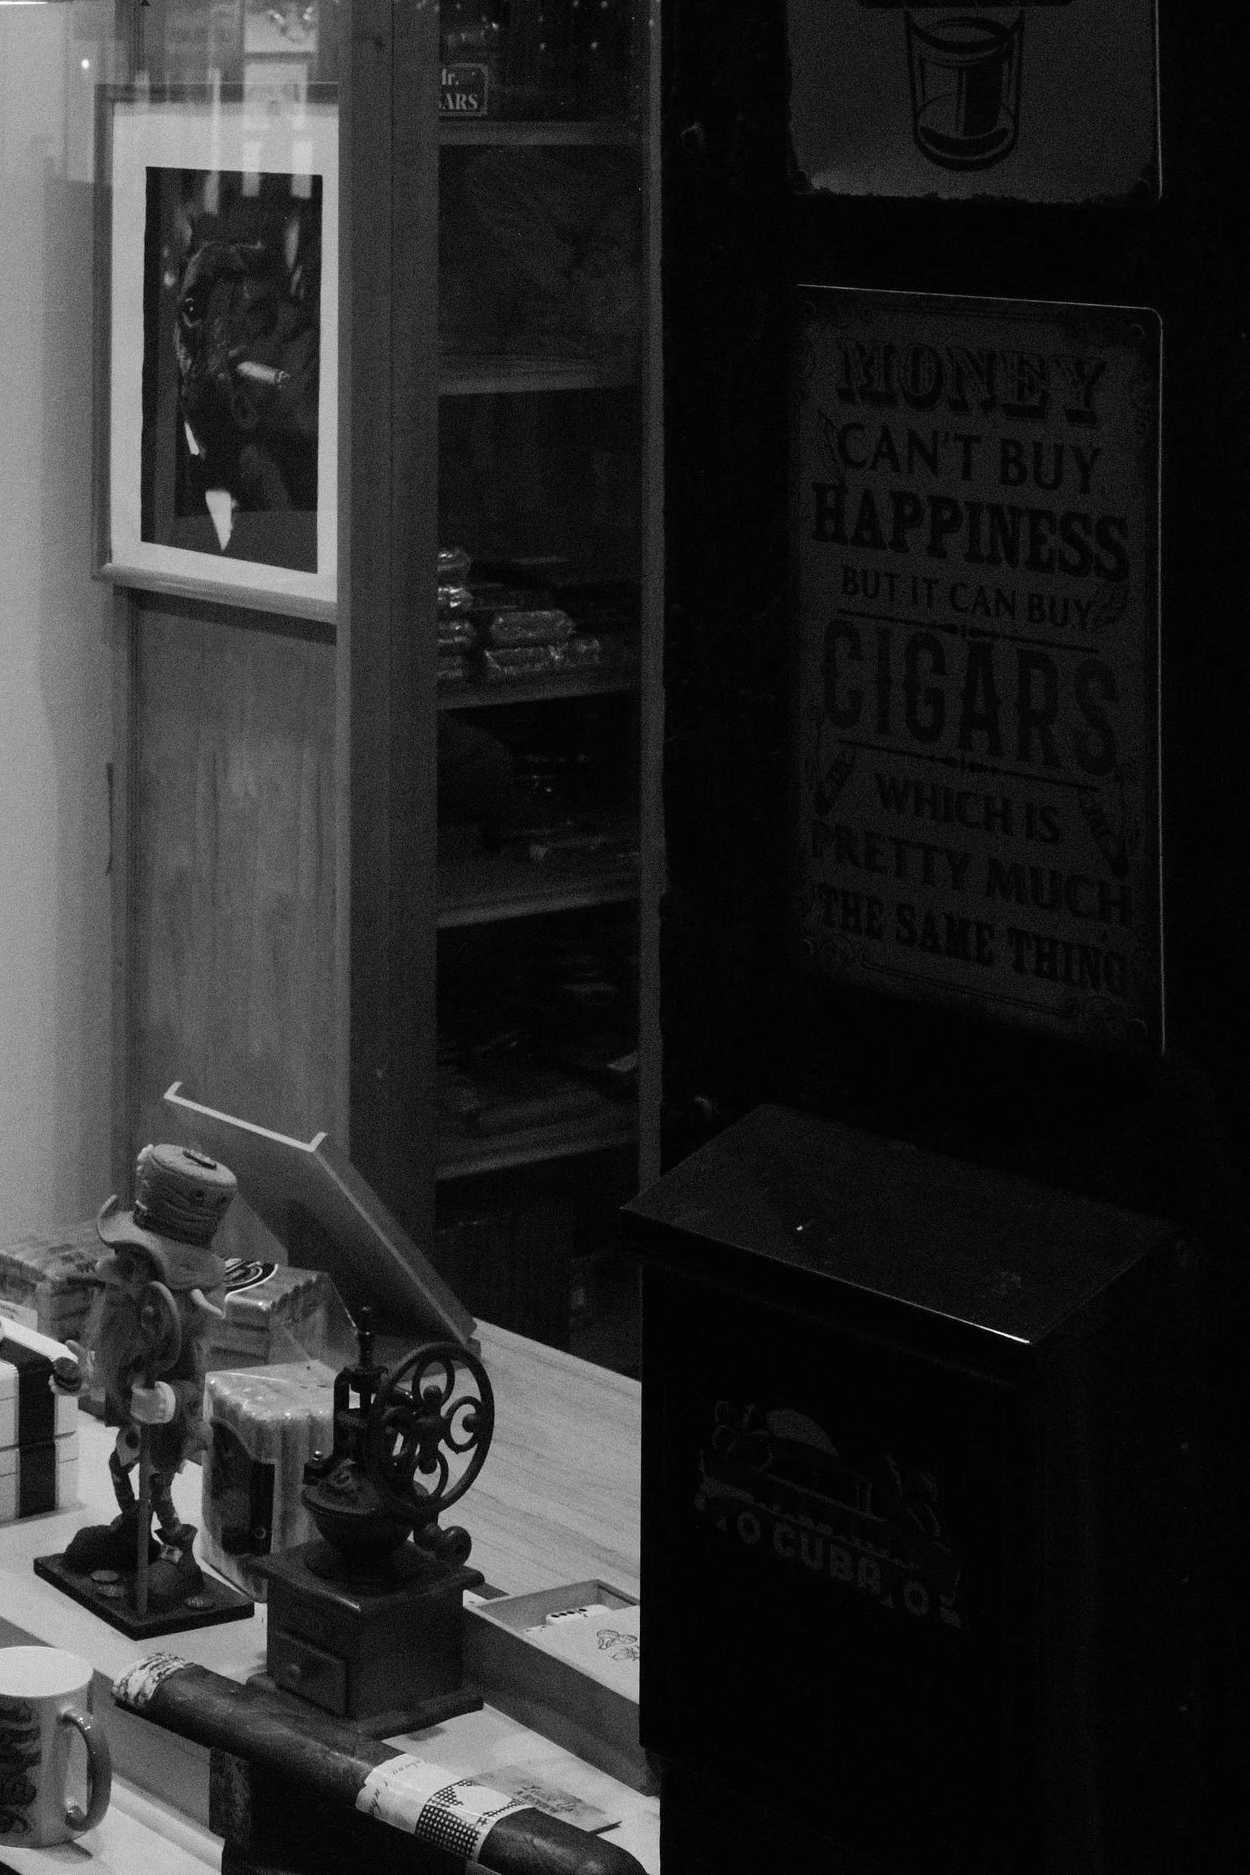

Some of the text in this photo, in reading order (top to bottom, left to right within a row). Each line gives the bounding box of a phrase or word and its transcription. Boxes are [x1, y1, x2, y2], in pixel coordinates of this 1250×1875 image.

[835, 335, 1107, 425] MONEY
[837, 423, 1101, 495] CAN'T BUY
[812, 481, 1130, 583] HAPPINESS
[842, 566, 1094, 630] BUT IT CAN BUY
[822, 619, 1119, 776] CIGARS
[874, 772, 1061, 844] WHICH IS
[811, 820, 1132, 926] PRETTY MUCH
[817, 883, 884, 940] THE
[895, 903, 995, 966] SAME
